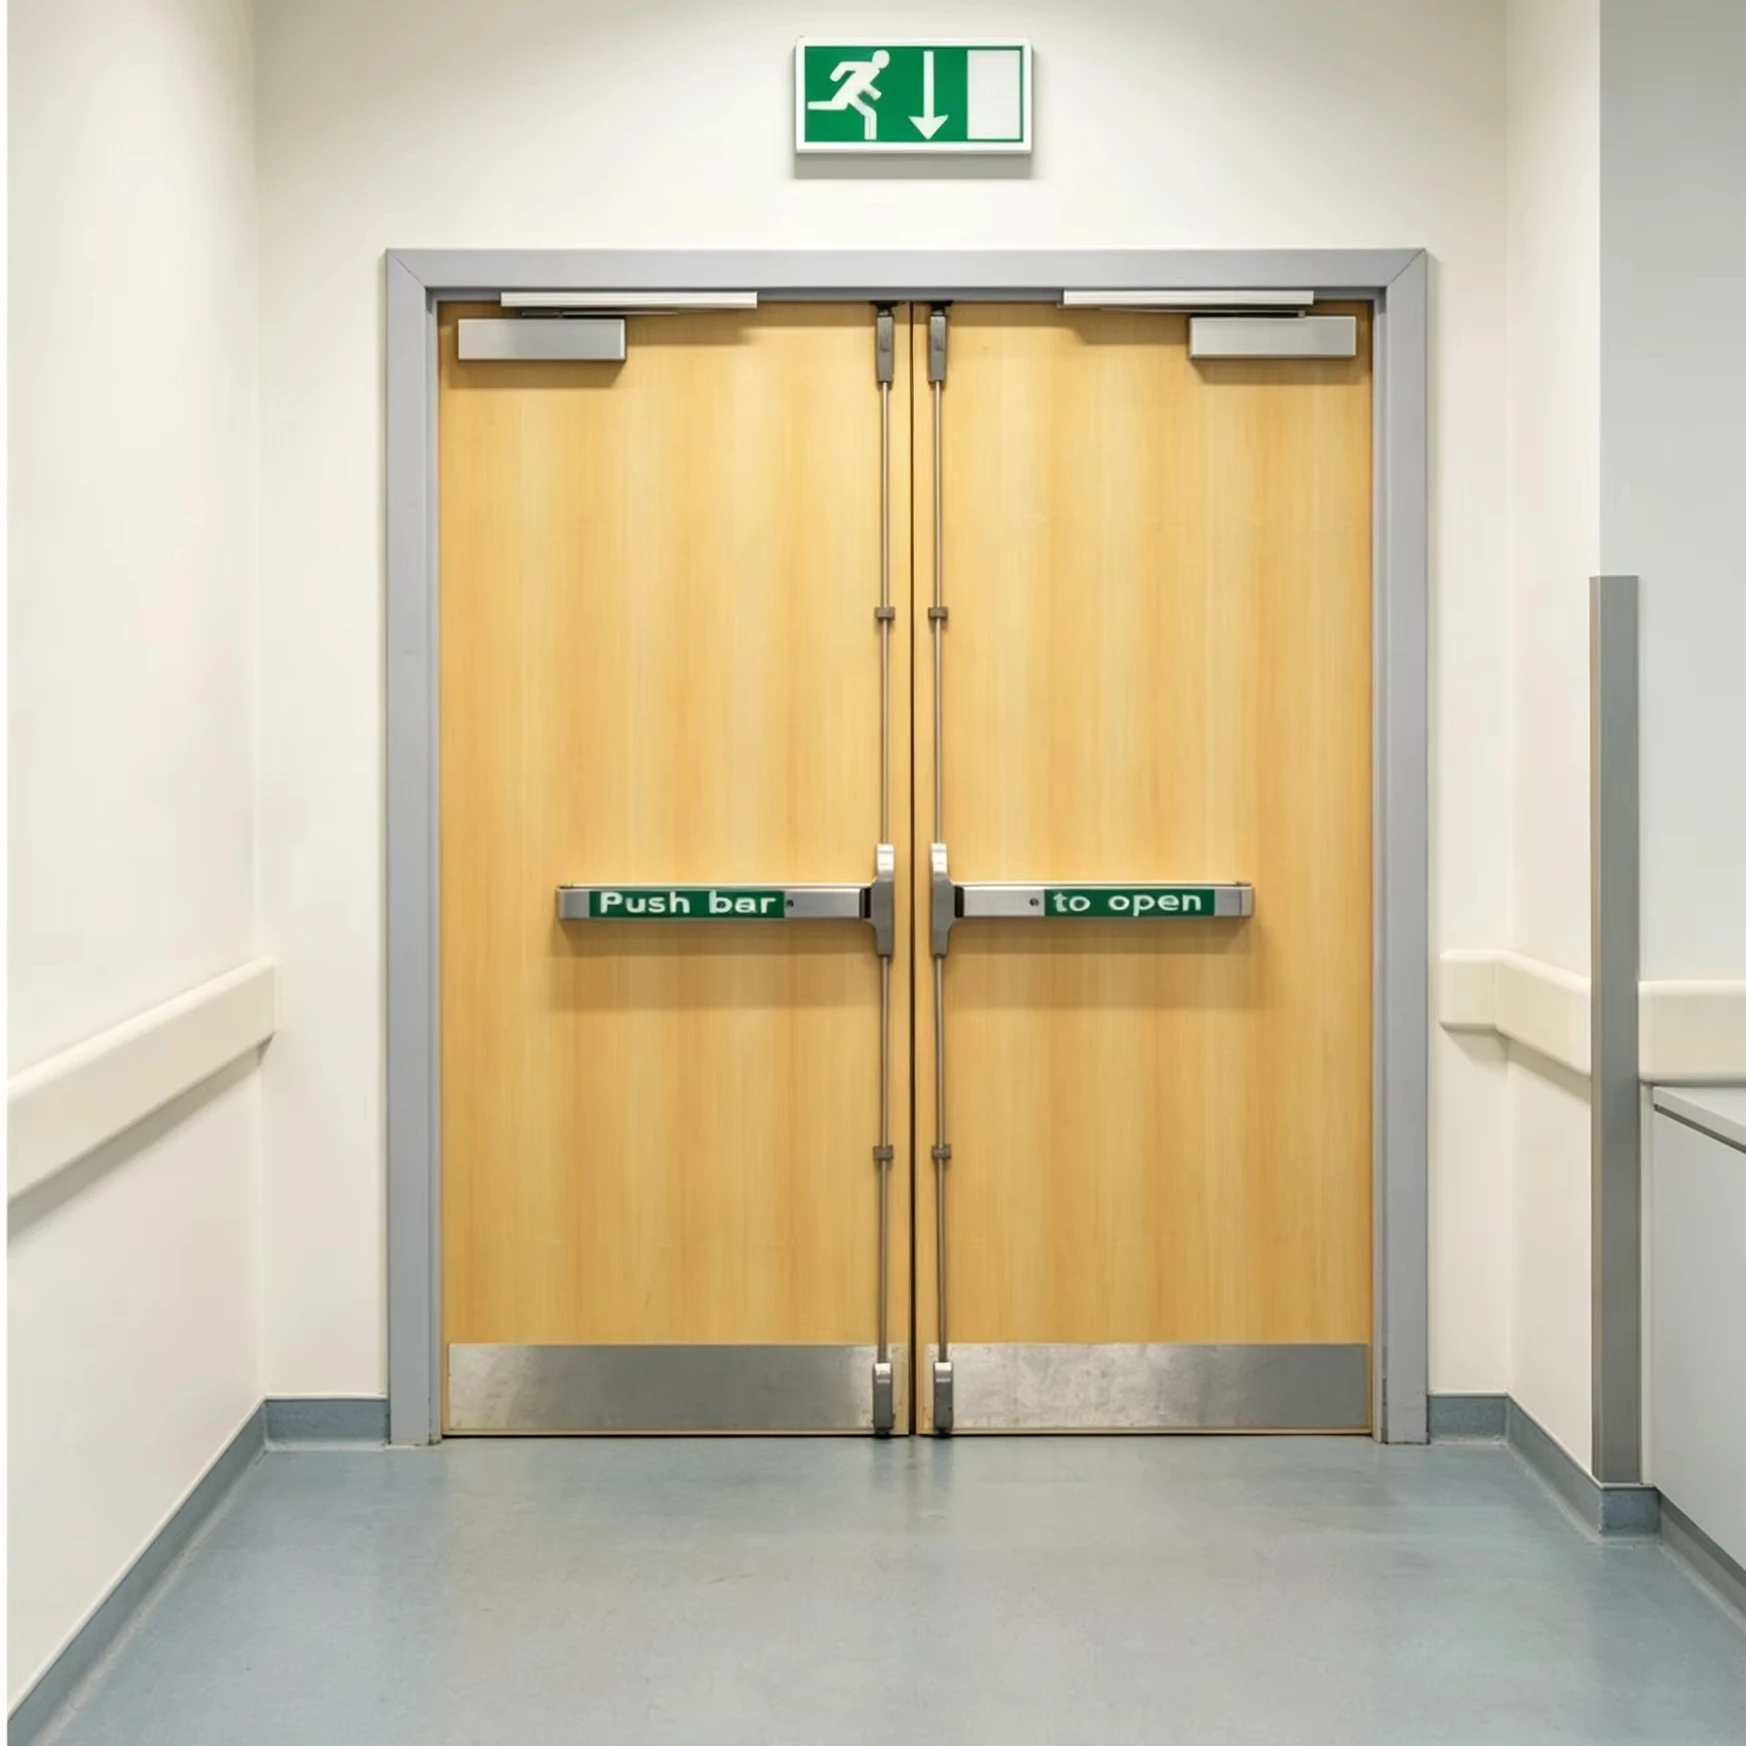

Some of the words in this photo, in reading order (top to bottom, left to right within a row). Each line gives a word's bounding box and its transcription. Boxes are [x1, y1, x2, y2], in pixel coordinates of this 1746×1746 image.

[600, 891, 691, 913] Push
[709, 890, 776, 913] bar
[1053, 892, 1091, 912] to
[1108, 894, 1202, 917] open
